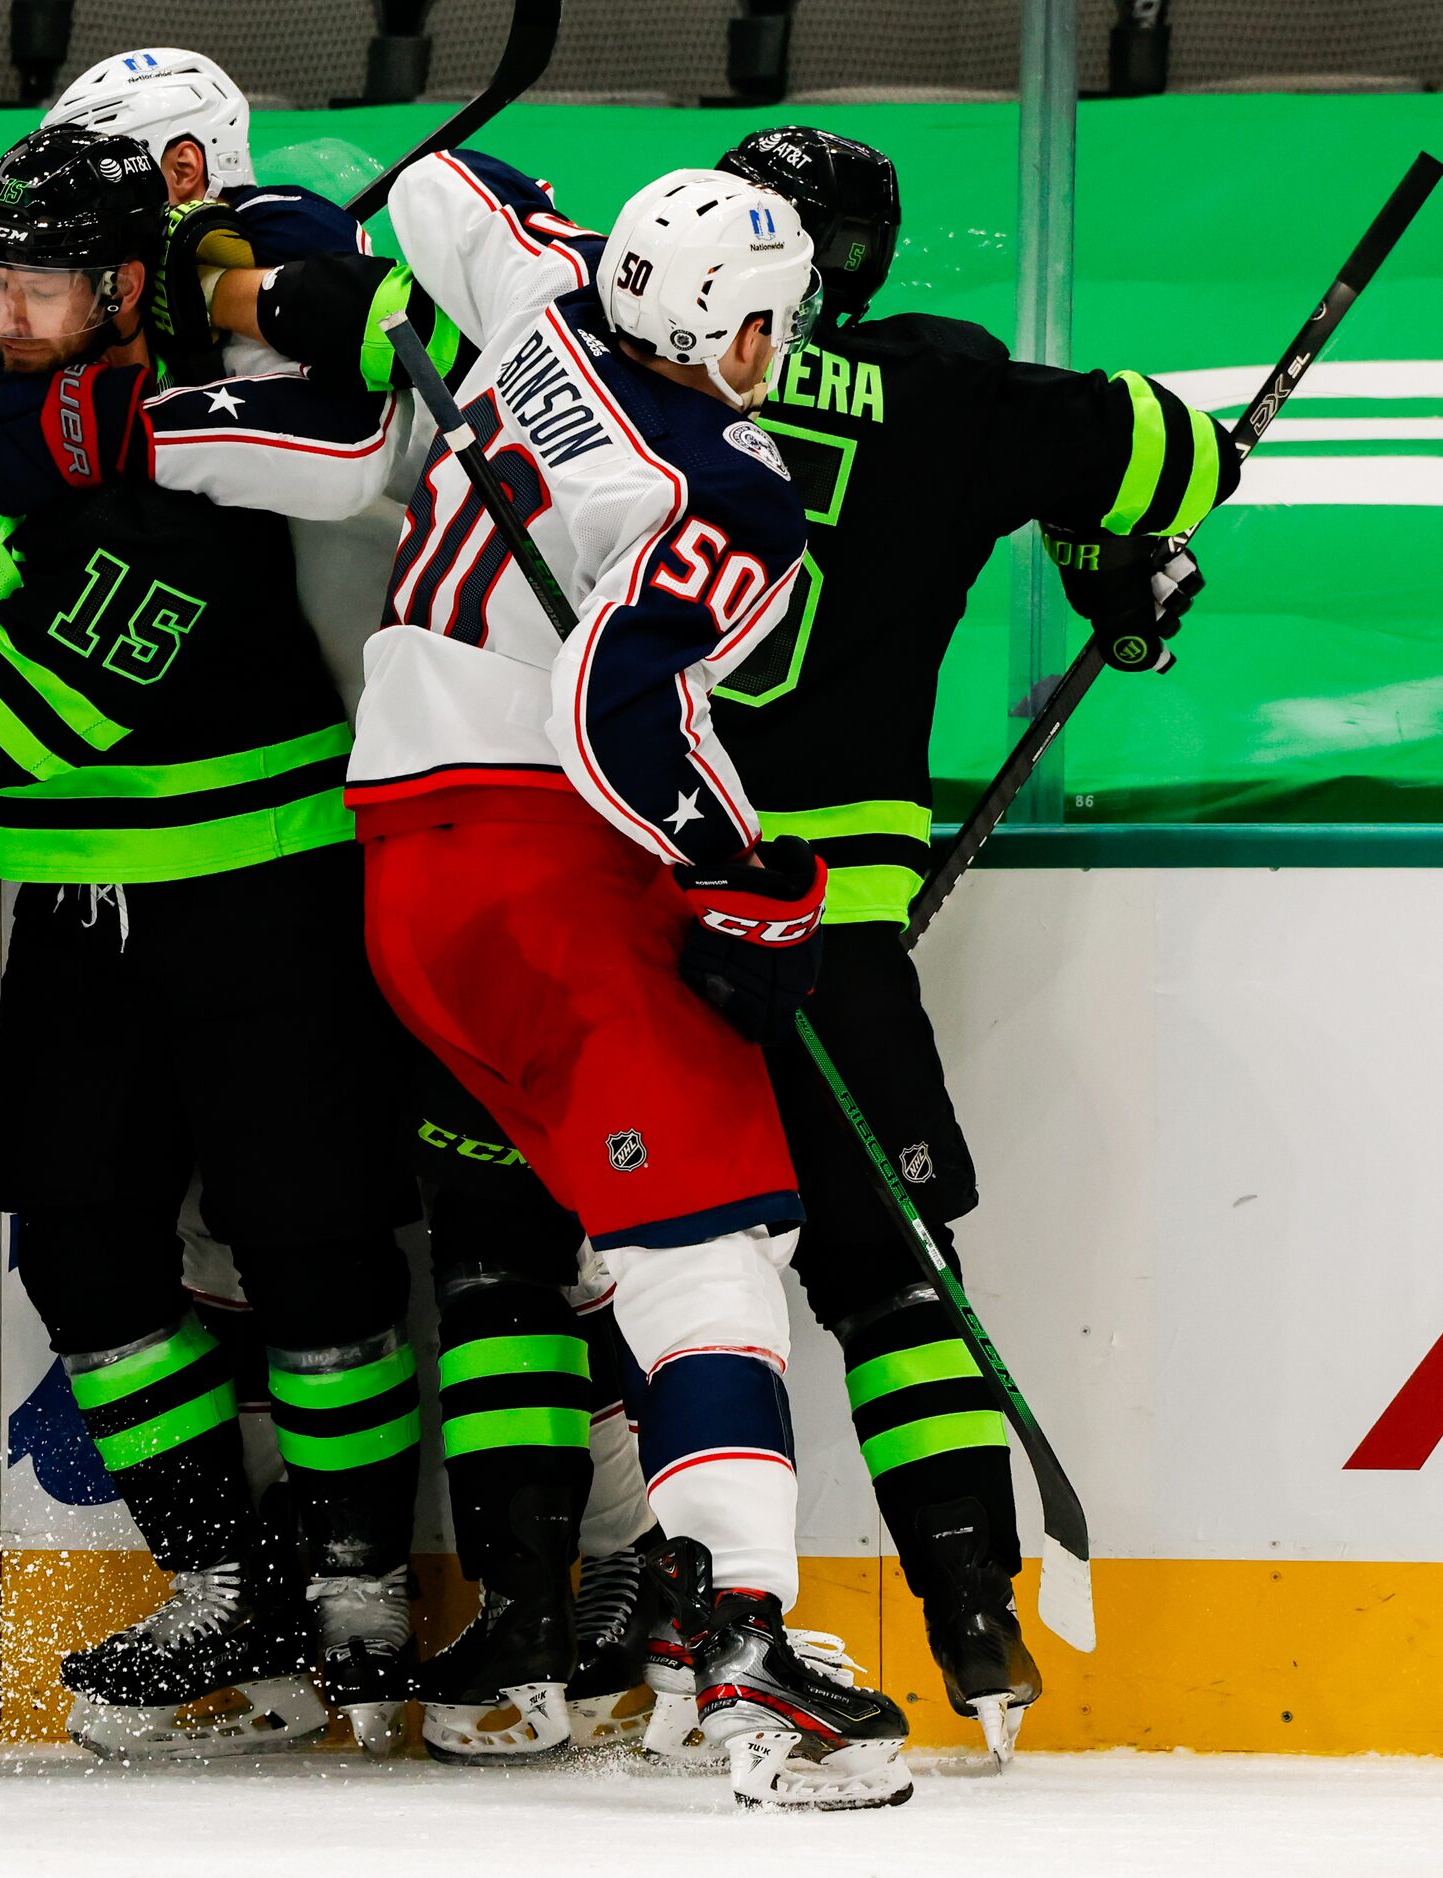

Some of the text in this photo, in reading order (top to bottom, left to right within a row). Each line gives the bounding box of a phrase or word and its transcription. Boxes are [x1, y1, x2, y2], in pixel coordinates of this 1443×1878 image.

[123, 154, 153, 176] AT&T
[772, 141, 812, 171] AT&T
[750, 243, 784, 252] Nationwide
[845, 242, 865, 272] 5
[617, 251, 654, 297] 50
[1287, 352, 1311, 379] SL
[648, 515, 769, 635] 50
[47, 547, 207, 686] 15
[1075, 795, 1094, 807] 86
[617, 1140, 638, 1165] NHL
[840, 1090, 908, 1203] RIBCOR
[909, 1152, 926, 1178] NHL
[961, 1304, 1020, 1394] CCM
